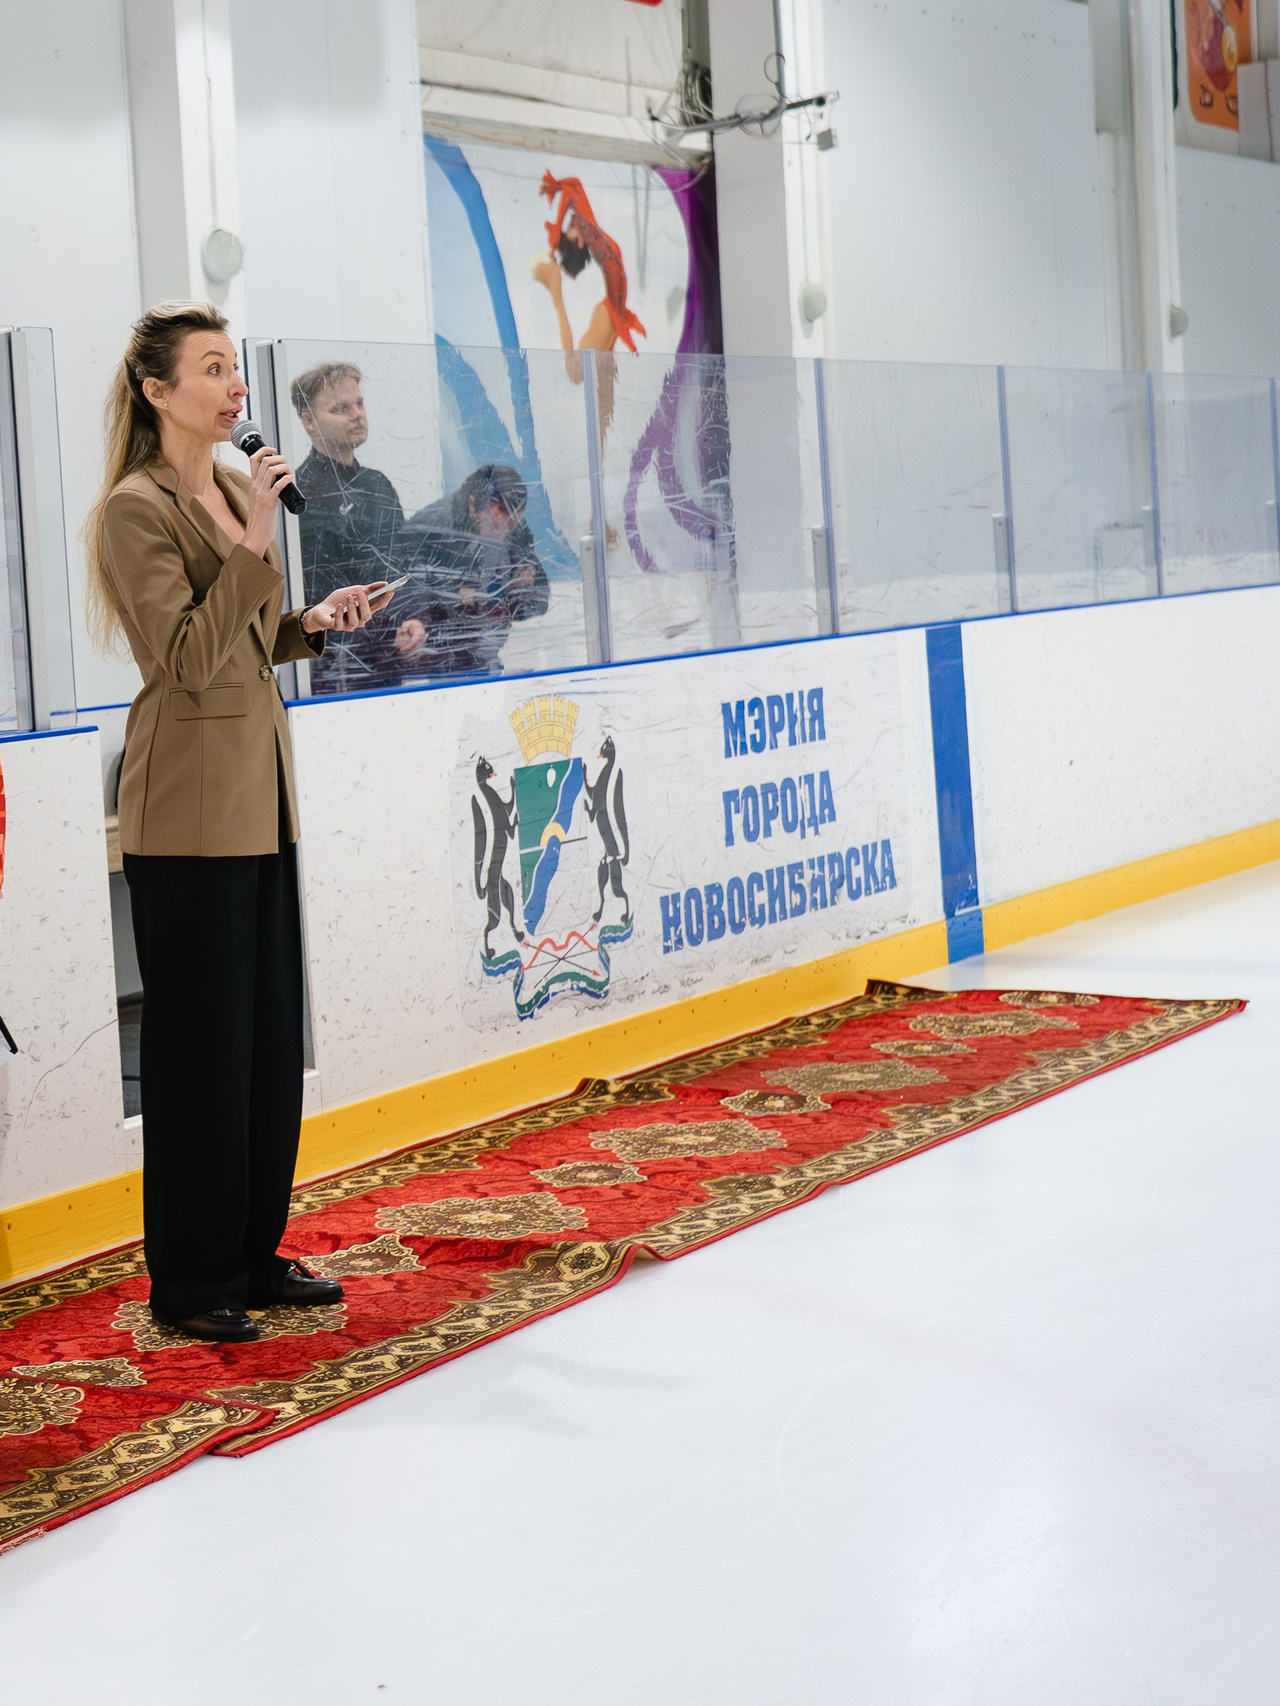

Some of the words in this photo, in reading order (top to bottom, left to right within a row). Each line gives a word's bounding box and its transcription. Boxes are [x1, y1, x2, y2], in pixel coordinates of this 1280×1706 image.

[721, 687, 826, 759] МЭРИЯ
[722, 770, 836, 847] ГОРОДА
[659, 838, 897, 955] НОВОСИБИРСКА
